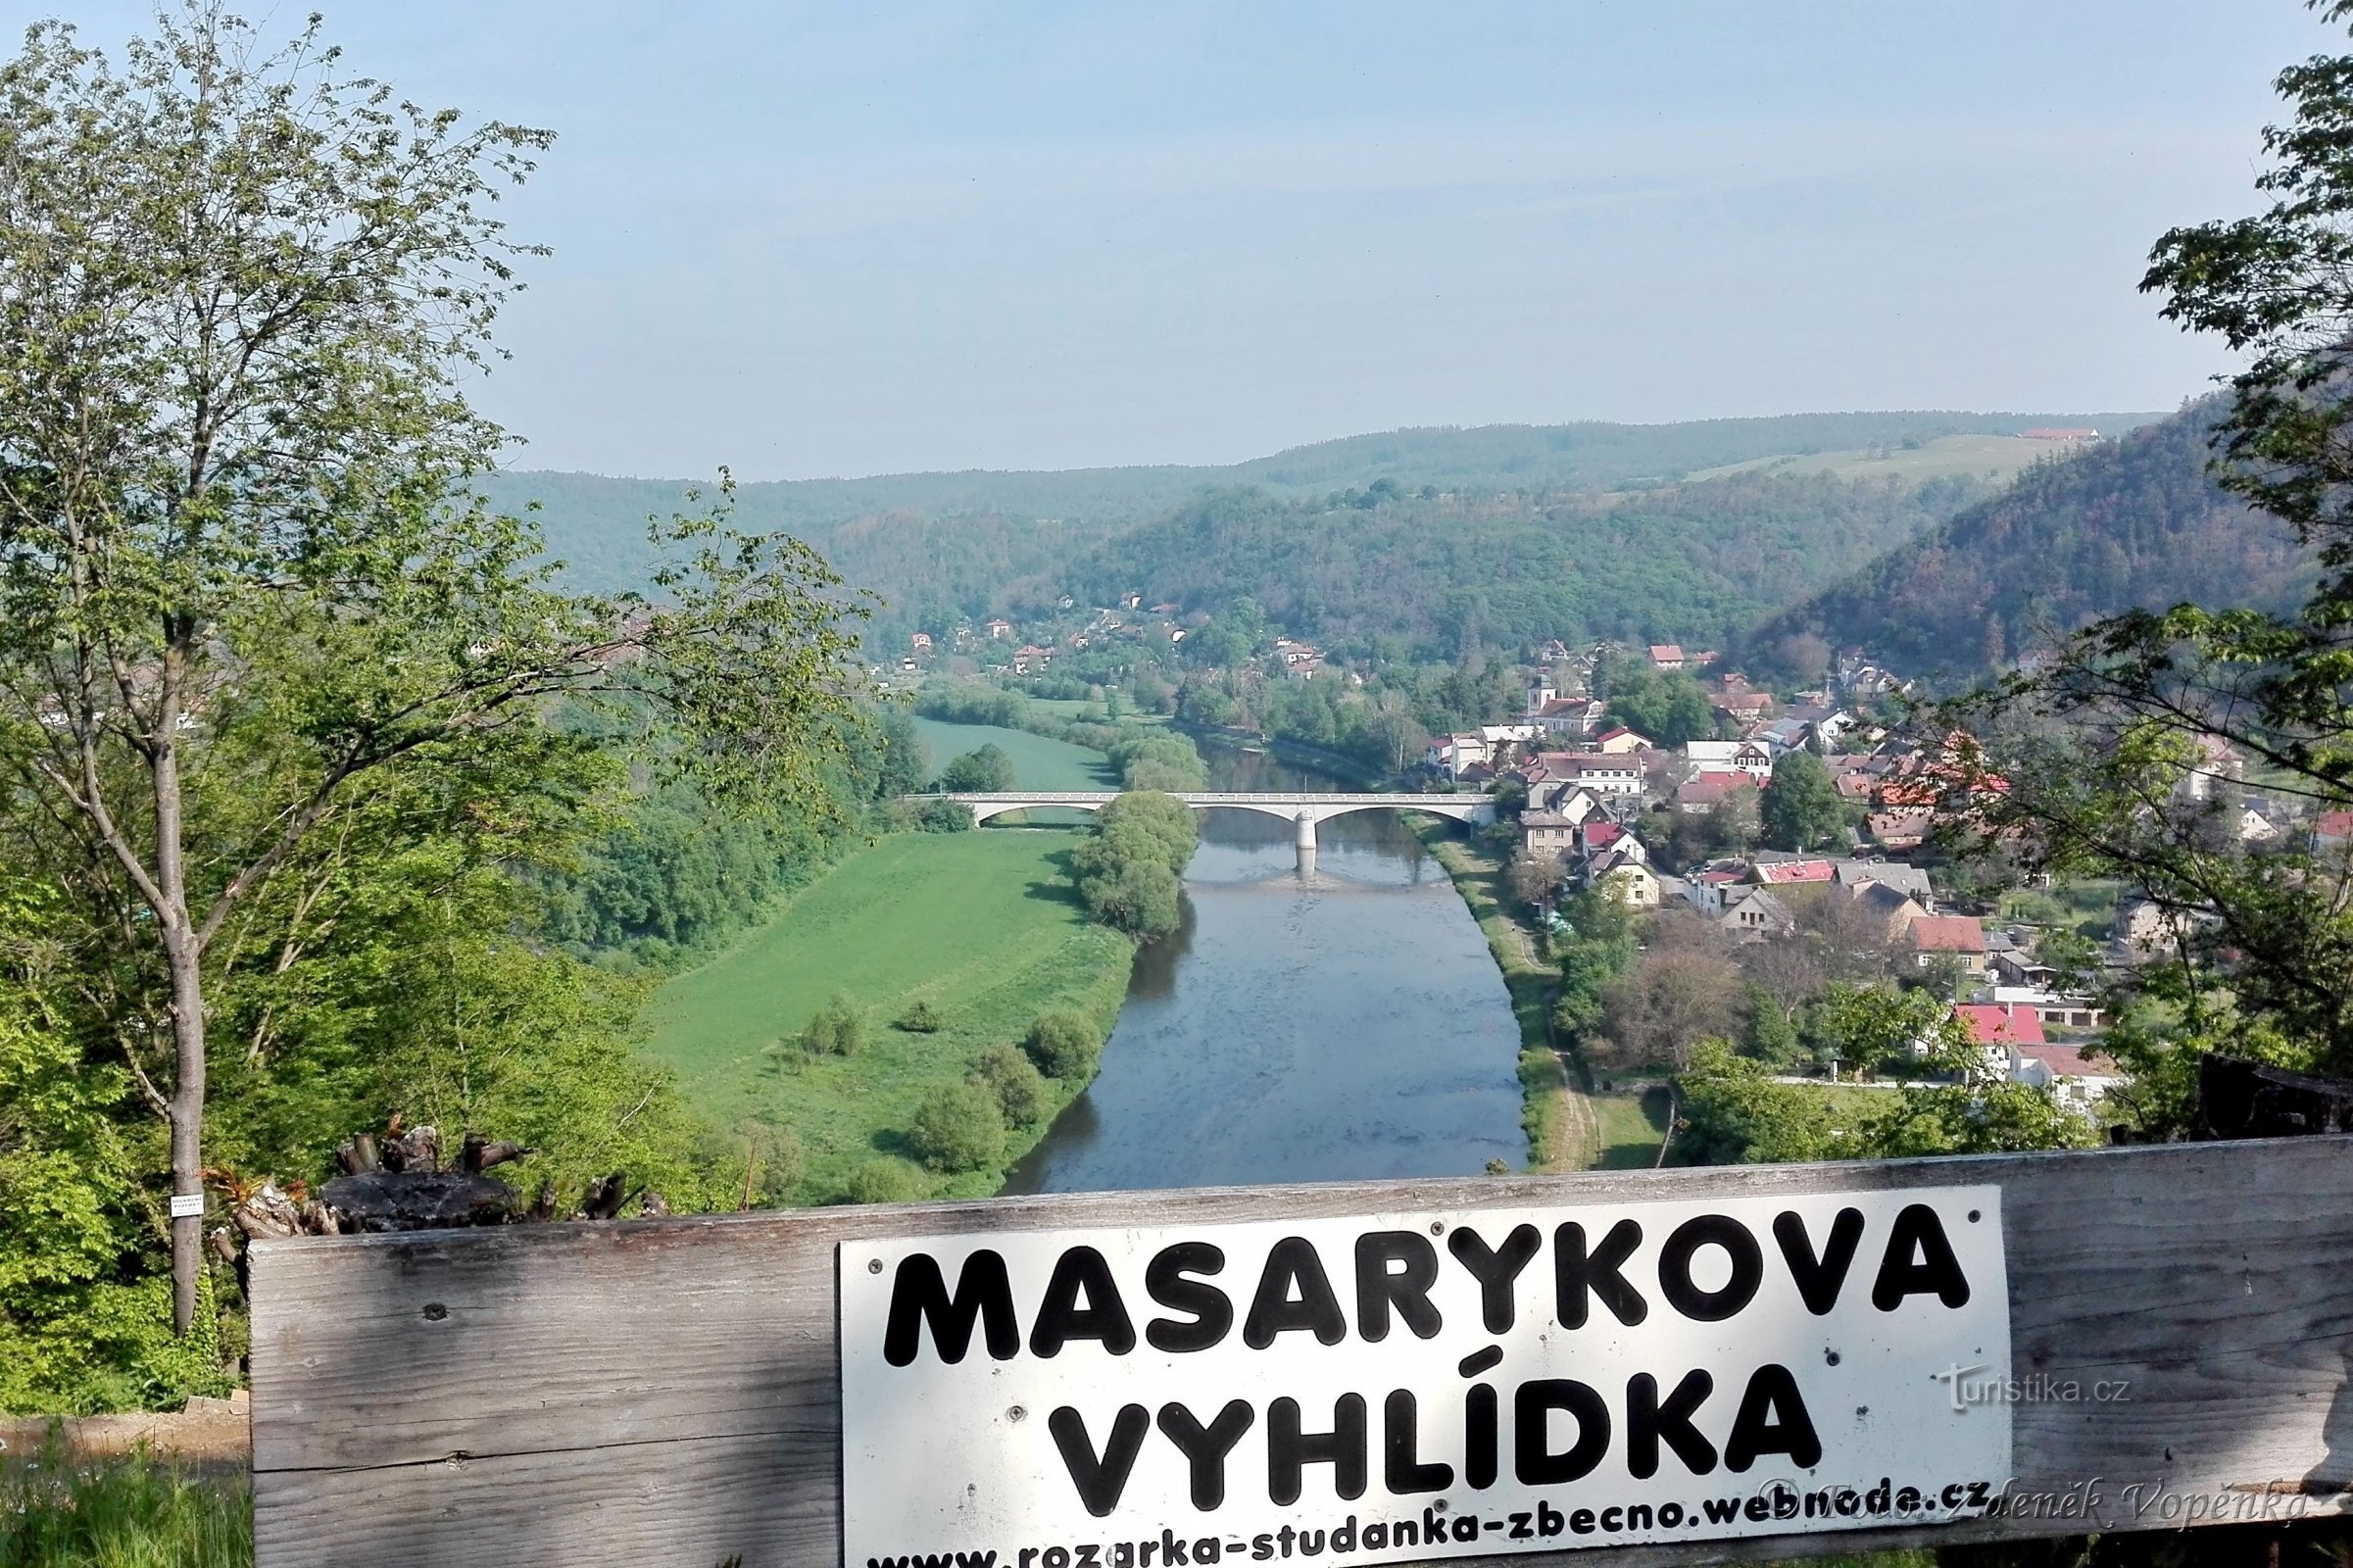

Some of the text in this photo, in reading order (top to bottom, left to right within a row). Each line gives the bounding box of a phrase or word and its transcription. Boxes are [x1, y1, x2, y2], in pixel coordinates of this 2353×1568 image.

[883, 1204, 1970, 1368] MASARYKOVA
[1048, 1344, 1823, 1518] VYHLÍDKA
[866, 1477, 1990, 1568] wwwrozarka-studanka-zbecno.webnode.cz
